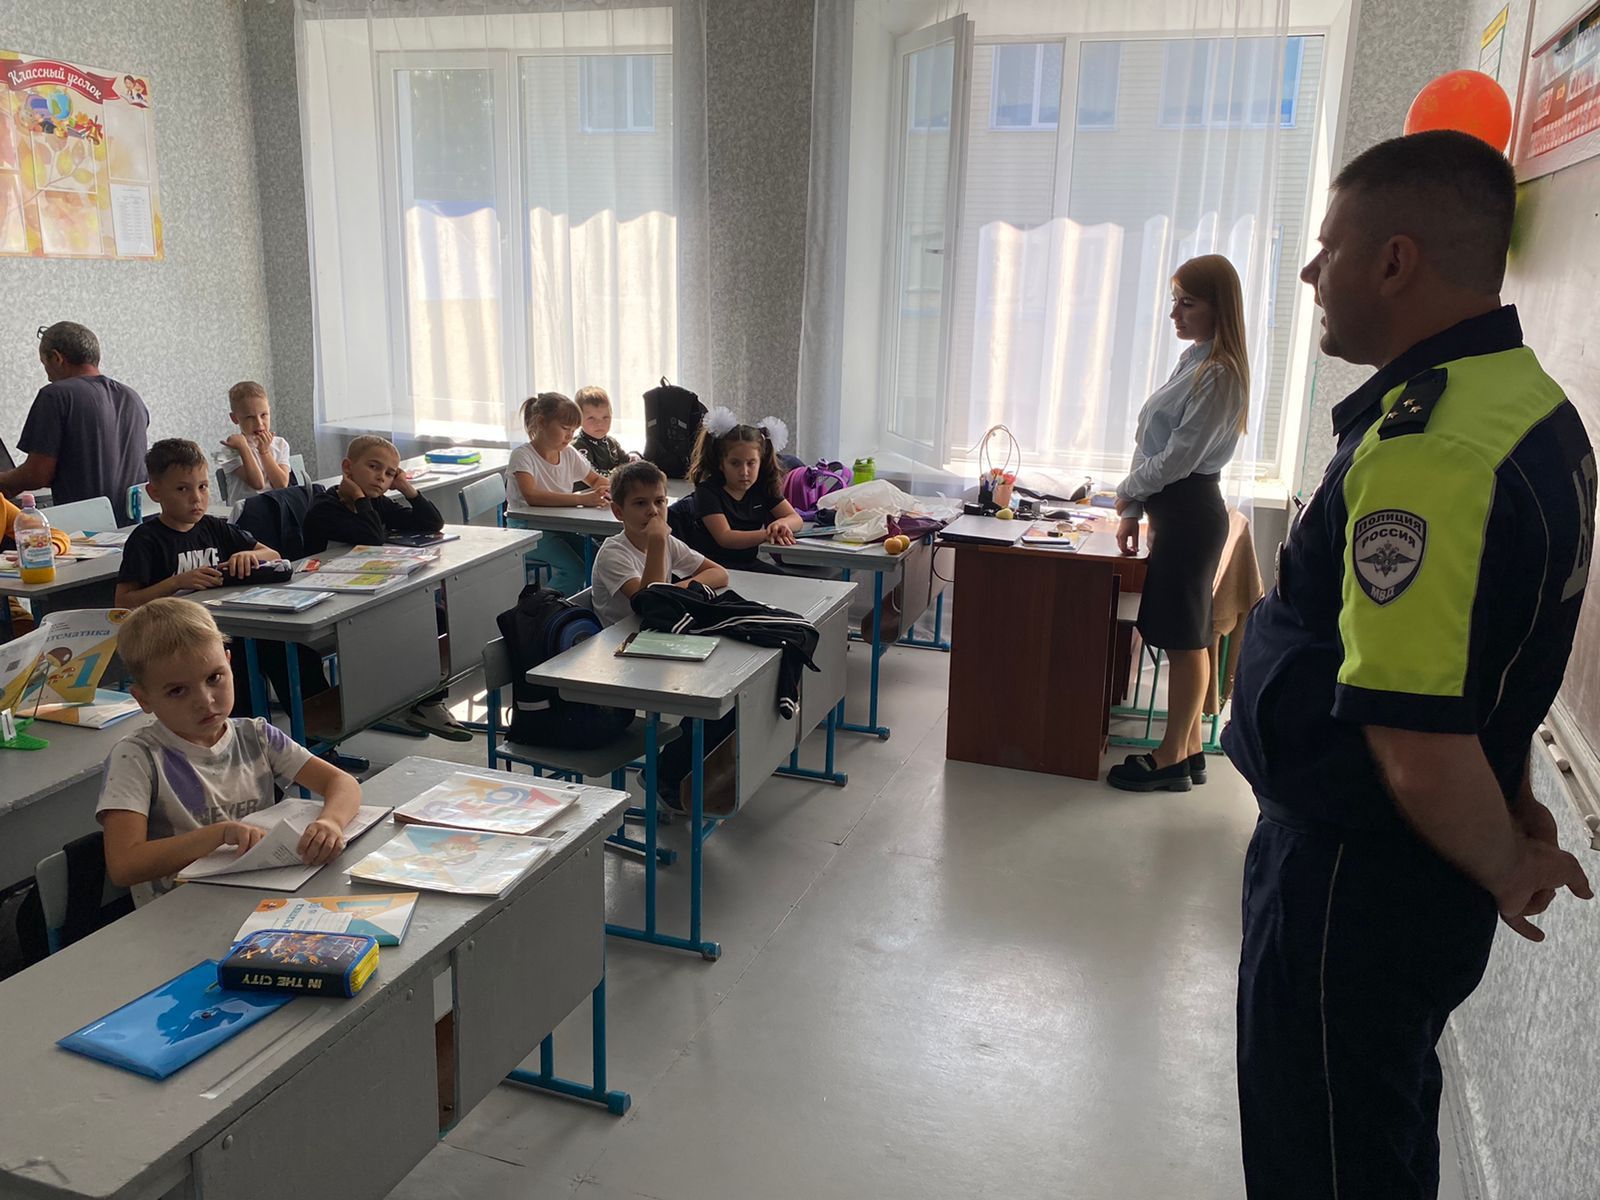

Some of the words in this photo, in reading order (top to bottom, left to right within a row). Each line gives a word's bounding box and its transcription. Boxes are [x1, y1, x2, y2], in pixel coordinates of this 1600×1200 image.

[8, 68, 65, 86] Классный
[66, 73, 102, 99] уголок
[1359, 513, 1421, 533] ПОЛИЦИЯ
[1362, 528, 1416, 549] РОССИЯ
[177, 547, 220, 576] NIKE
[1370, 586, 1395, 601] МВД
[46, 629, 111, 642] тематика
[242, 974, 273, 986] CITY
[276, 976, 304, 988] THE
[307, 978, 323, 989] IN
